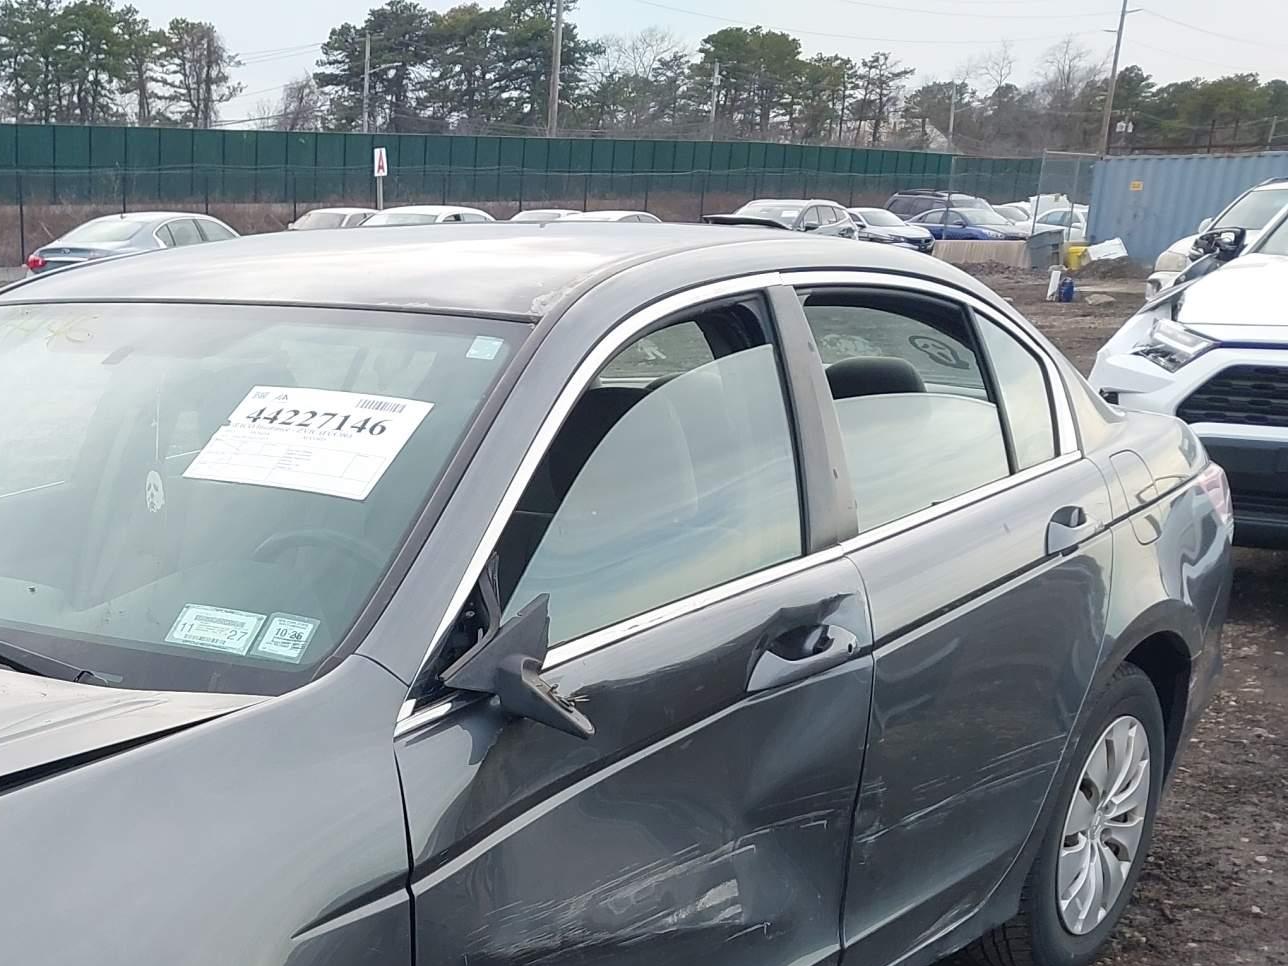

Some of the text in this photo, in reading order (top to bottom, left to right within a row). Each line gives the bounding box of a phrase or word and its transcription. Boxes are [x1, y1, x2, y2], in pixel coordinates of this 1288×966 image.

[377, 149, 386, 174] A
[246, 406, 393, 436] 44227146
[180, 622, 194, 633] 11
[227, 630, 248, 642] 27
